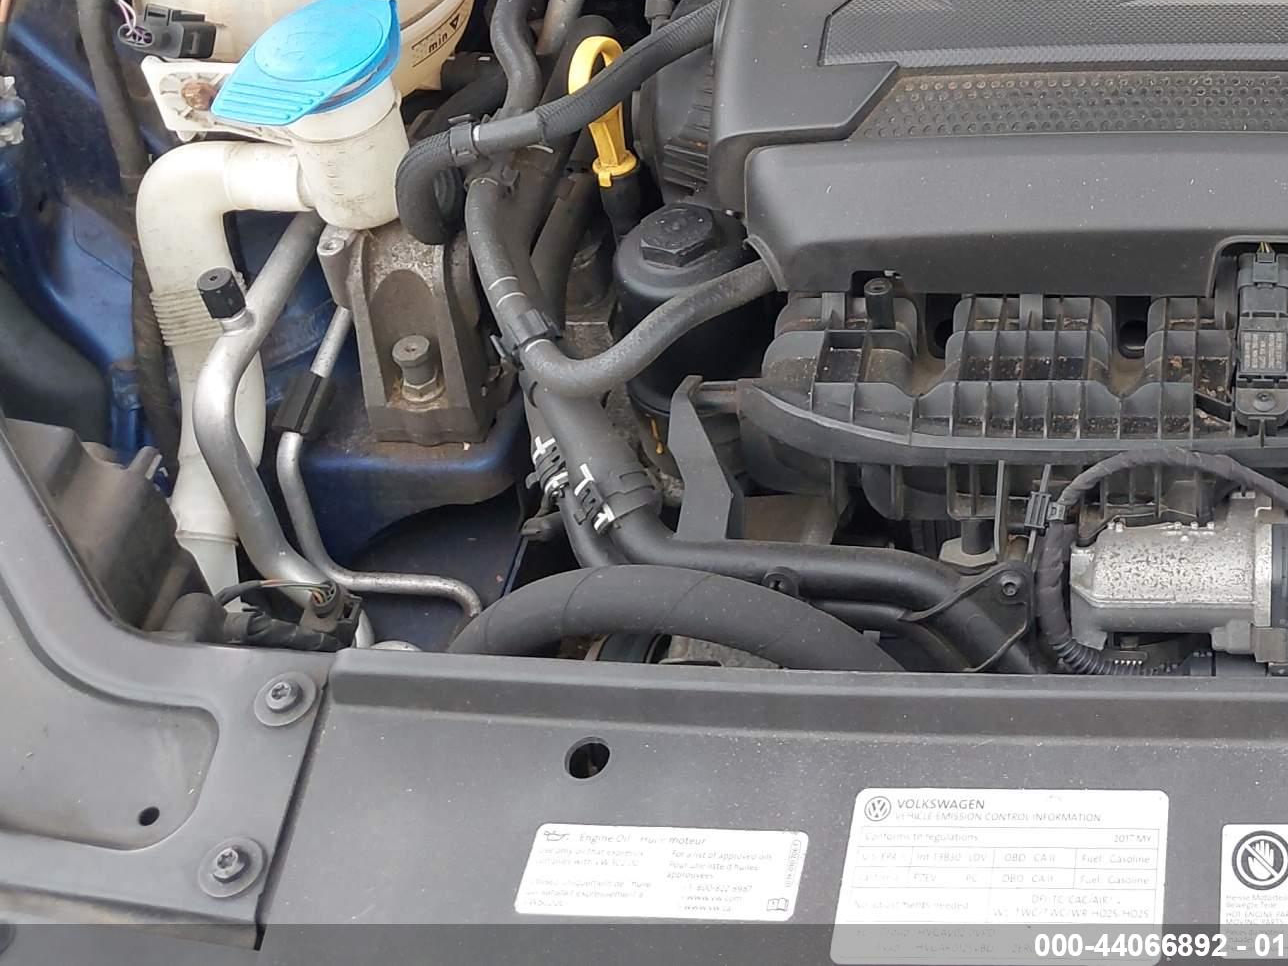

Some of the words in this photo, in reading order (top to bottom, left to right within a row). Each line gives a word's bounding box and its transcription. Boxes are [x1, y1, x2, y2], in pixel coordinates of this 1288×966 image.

[428, 31, 448, 53] min
[897, 798, 985, 810] VOLKSWAGEN
[1032, 812, 1101, 823] INFORMATION
